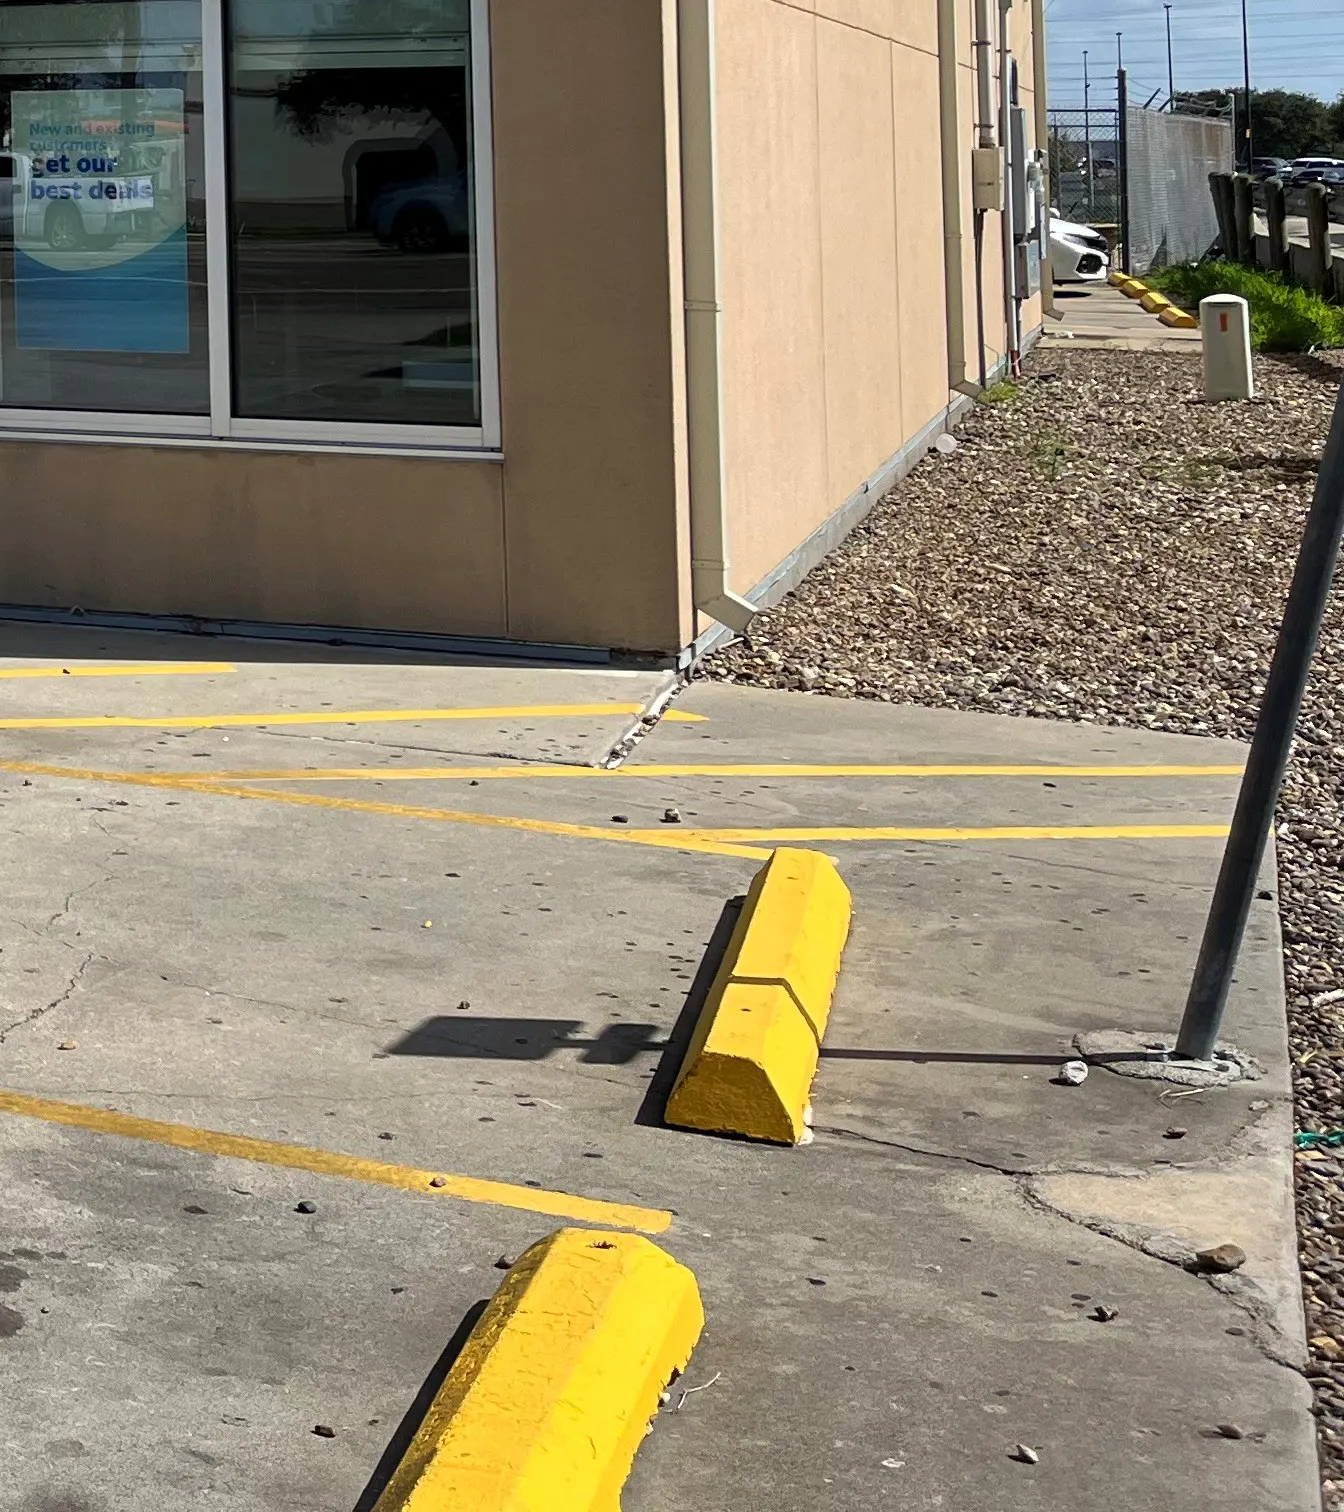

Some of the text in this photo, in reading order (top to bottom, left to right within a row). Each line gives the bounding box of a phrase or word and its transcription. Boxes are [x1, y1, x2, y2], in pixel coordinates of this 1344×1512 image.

[30, 120, 155, 138] New and existing
[31, 155, 117, 178] get our
[30, 180, 82, 200] best
